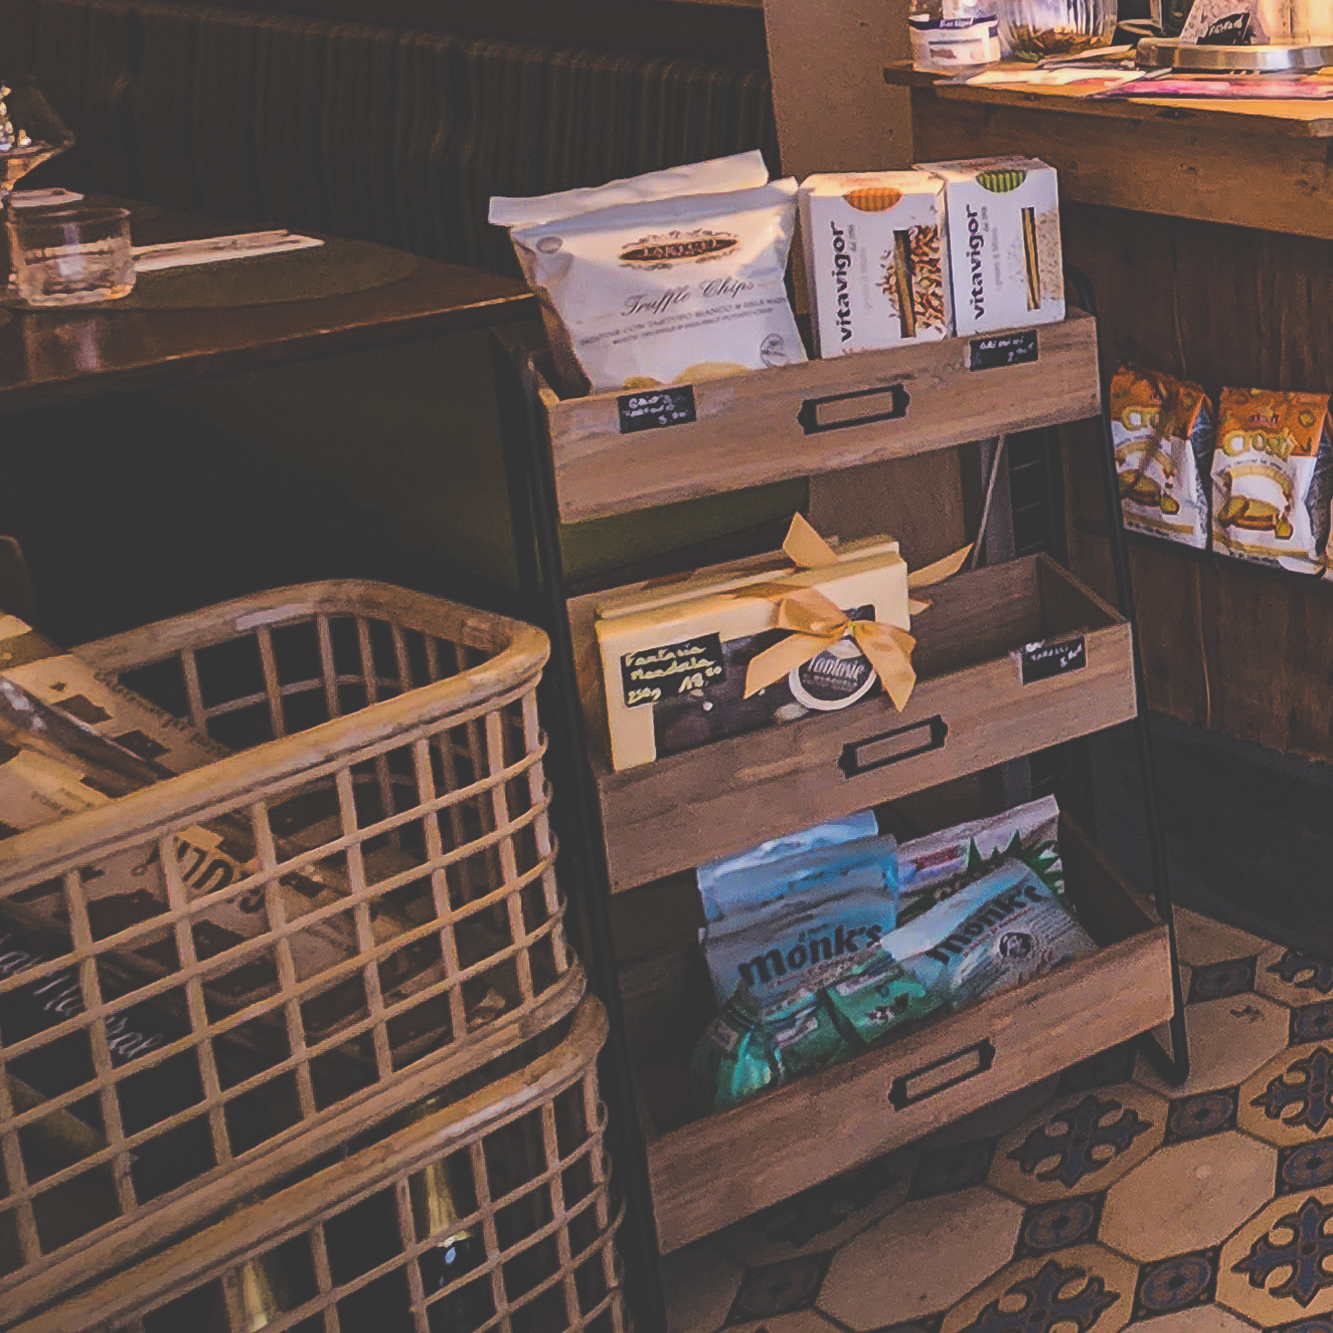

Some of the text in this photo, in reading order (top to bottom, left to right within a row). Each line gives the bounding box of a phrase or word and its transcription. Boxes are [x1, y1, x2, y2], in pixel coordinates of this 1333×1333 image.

[621, 276, 755, 315] Truffle Chips
[829, 220, 854, 344] vitavigor
[965, 203, 986, 320] vitavigor
